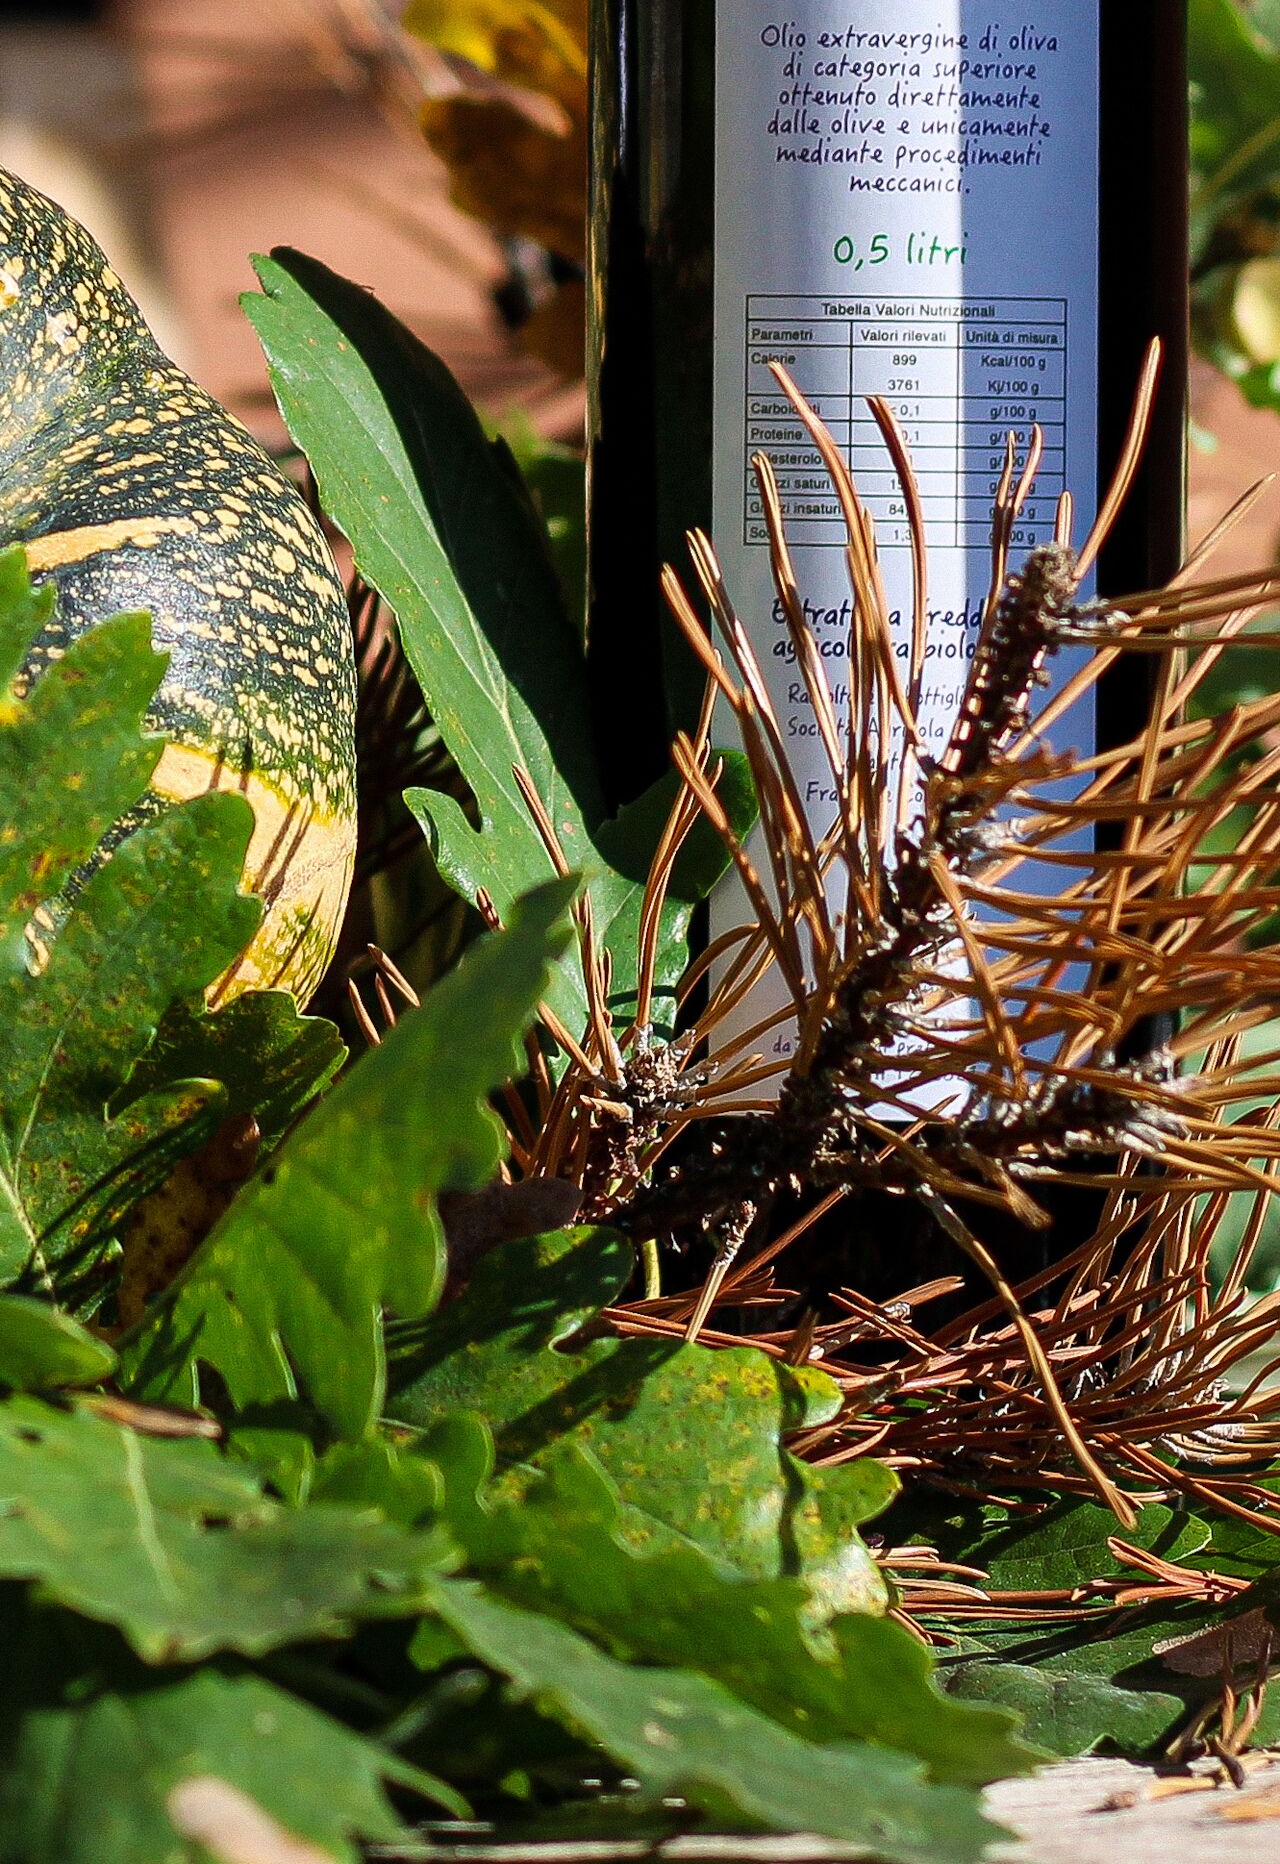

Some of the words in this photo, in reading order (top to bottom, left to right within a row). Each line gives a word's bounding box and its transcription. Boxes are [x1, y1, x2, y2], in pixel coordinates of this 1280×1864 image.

[760, 23, 806, 48] Olio
[817, 23, 969, 54] extravergine
[978, 24, 1001, 50] di
[1008, 26, 1058, 51] oliva
[783, 52, 803, 79] di
[814, 52, 921, 83] categoria
[932, 53, 1037, 85] superiore
[779, 82, 877, 107] ottenuto
[887, 81, 1041, 109] direttamente
[767, 108, 820, 135] dalle
[831, 110, 886, 135] olive
[897, 120, 911, 135] e
[921, 110, 1051, 138] unicamente
[776, 137, 884, 164] mediante
[894, 139, 1042, 168] procedimenti
[849, 166, 972, 194] meccanici.
[833, 235, 889, 271] 0,5
[907, 233, 968, 265] litri
[821, 303, 870, 316] Tabella
[875, 304, 915, 317] Valori
[920, 304, 995, 317] Nutrizionali
[751, 328, 813, 341] Parametri
[860, 329, 898, 341] Valori
[902, 330, 946, 342] rilevati
[1002, 331, 1014, 343] di
[1018, 332, 1058, 344] misura
[892, 355, 917, 365] 899
[981, 355, 1036, 368] Kcal/100
[1038, 359, 1046, 370] g
[888, 380, 920, 390] 3761
[1031, 384, 1039, 395] g
[900, 405, 919, 417] 0,1
[990, 405, 1026, 420] g/100
[1029, 408, 1036, 420] g
[751, 428, 803, 441] Proteine
[794, 479, 830, 489] saturi
[794, 502, 841, 514] insaturi
[1028, 508, 1036, 519] g
[1028, 532, 1035, 545] g
[889, 611, 901, 626] a
[926, 598, 985, 630] redd
[772, 1036, 791, 1053] da
